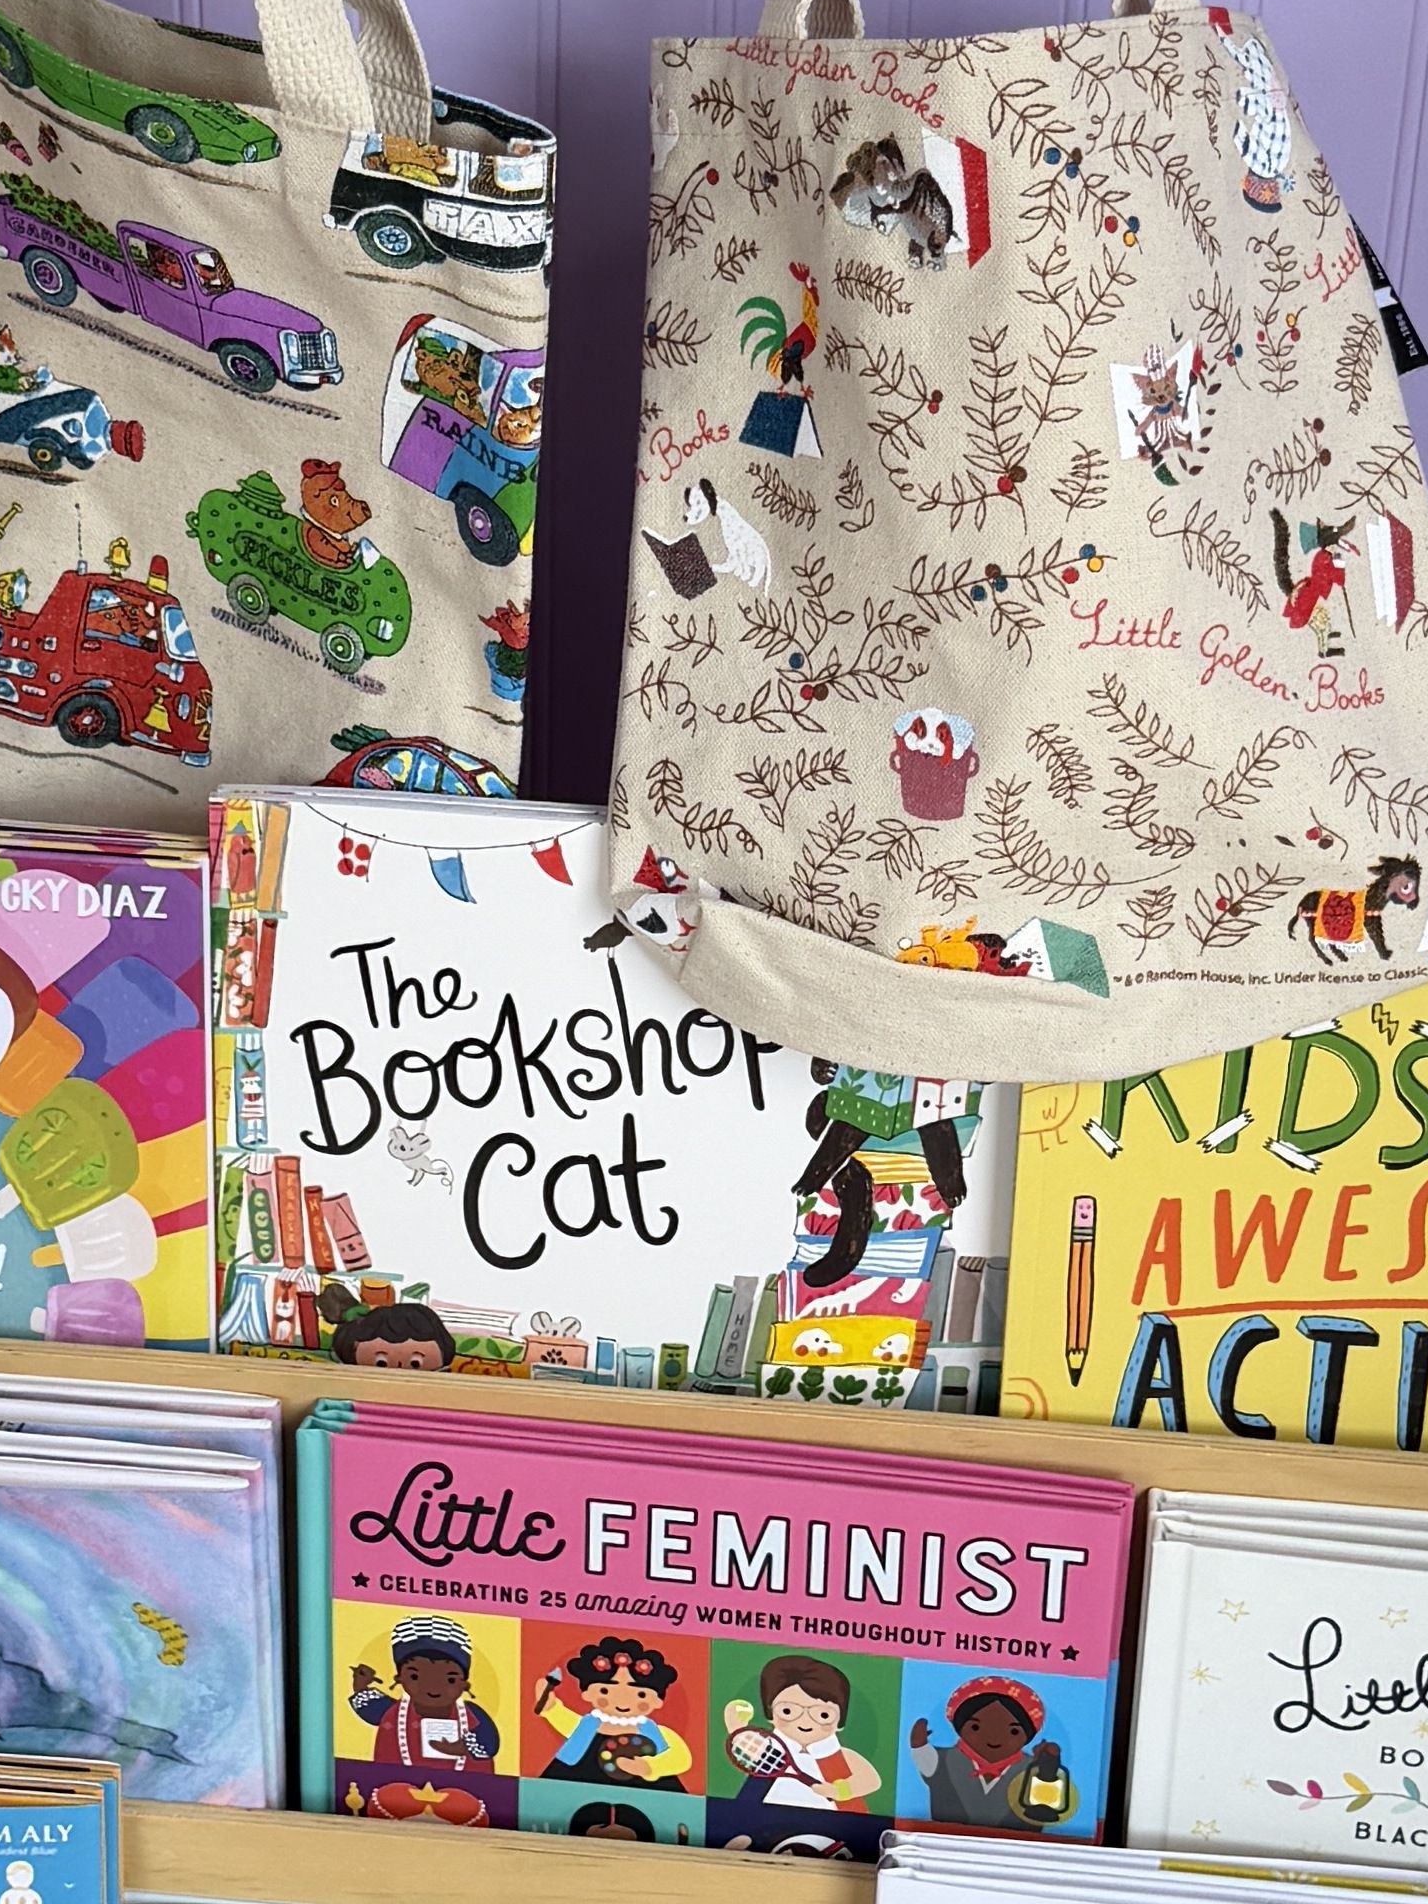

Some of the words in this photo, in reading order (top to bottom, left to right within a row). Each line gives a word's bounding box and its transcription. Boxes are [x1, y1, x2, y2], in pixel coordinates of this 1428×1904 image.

[240, 534, 360, 613] PICKLES
[1070, 598, 1182, 650] Little
[1200, 624, 1291, 686] Golden
[1304, 662, 1385, 713] Books
[76, 883, 169, 922] DIAZ
[332, 936, 478, 1030] The
[1274, 971, 1316, 984] Under
[462, 1112, 680, 1270] Cat
[349, 1461, 566, 1568] Little
[584, 1496, 1089, 1623] FEMINIST
[379, 1574, 529, 1607] CELEBRATING
[540, 1592, 568, 1610] 25
[574, 1589, 689, 1629] amazing
[697, 1605, 783, 1632] WOMEN
[789, 1614, 948, 1650] THROUGHOUT
[954, 1632, 1053, 1661] HISTORY
[20, 1822, 74, 1844] ALY
